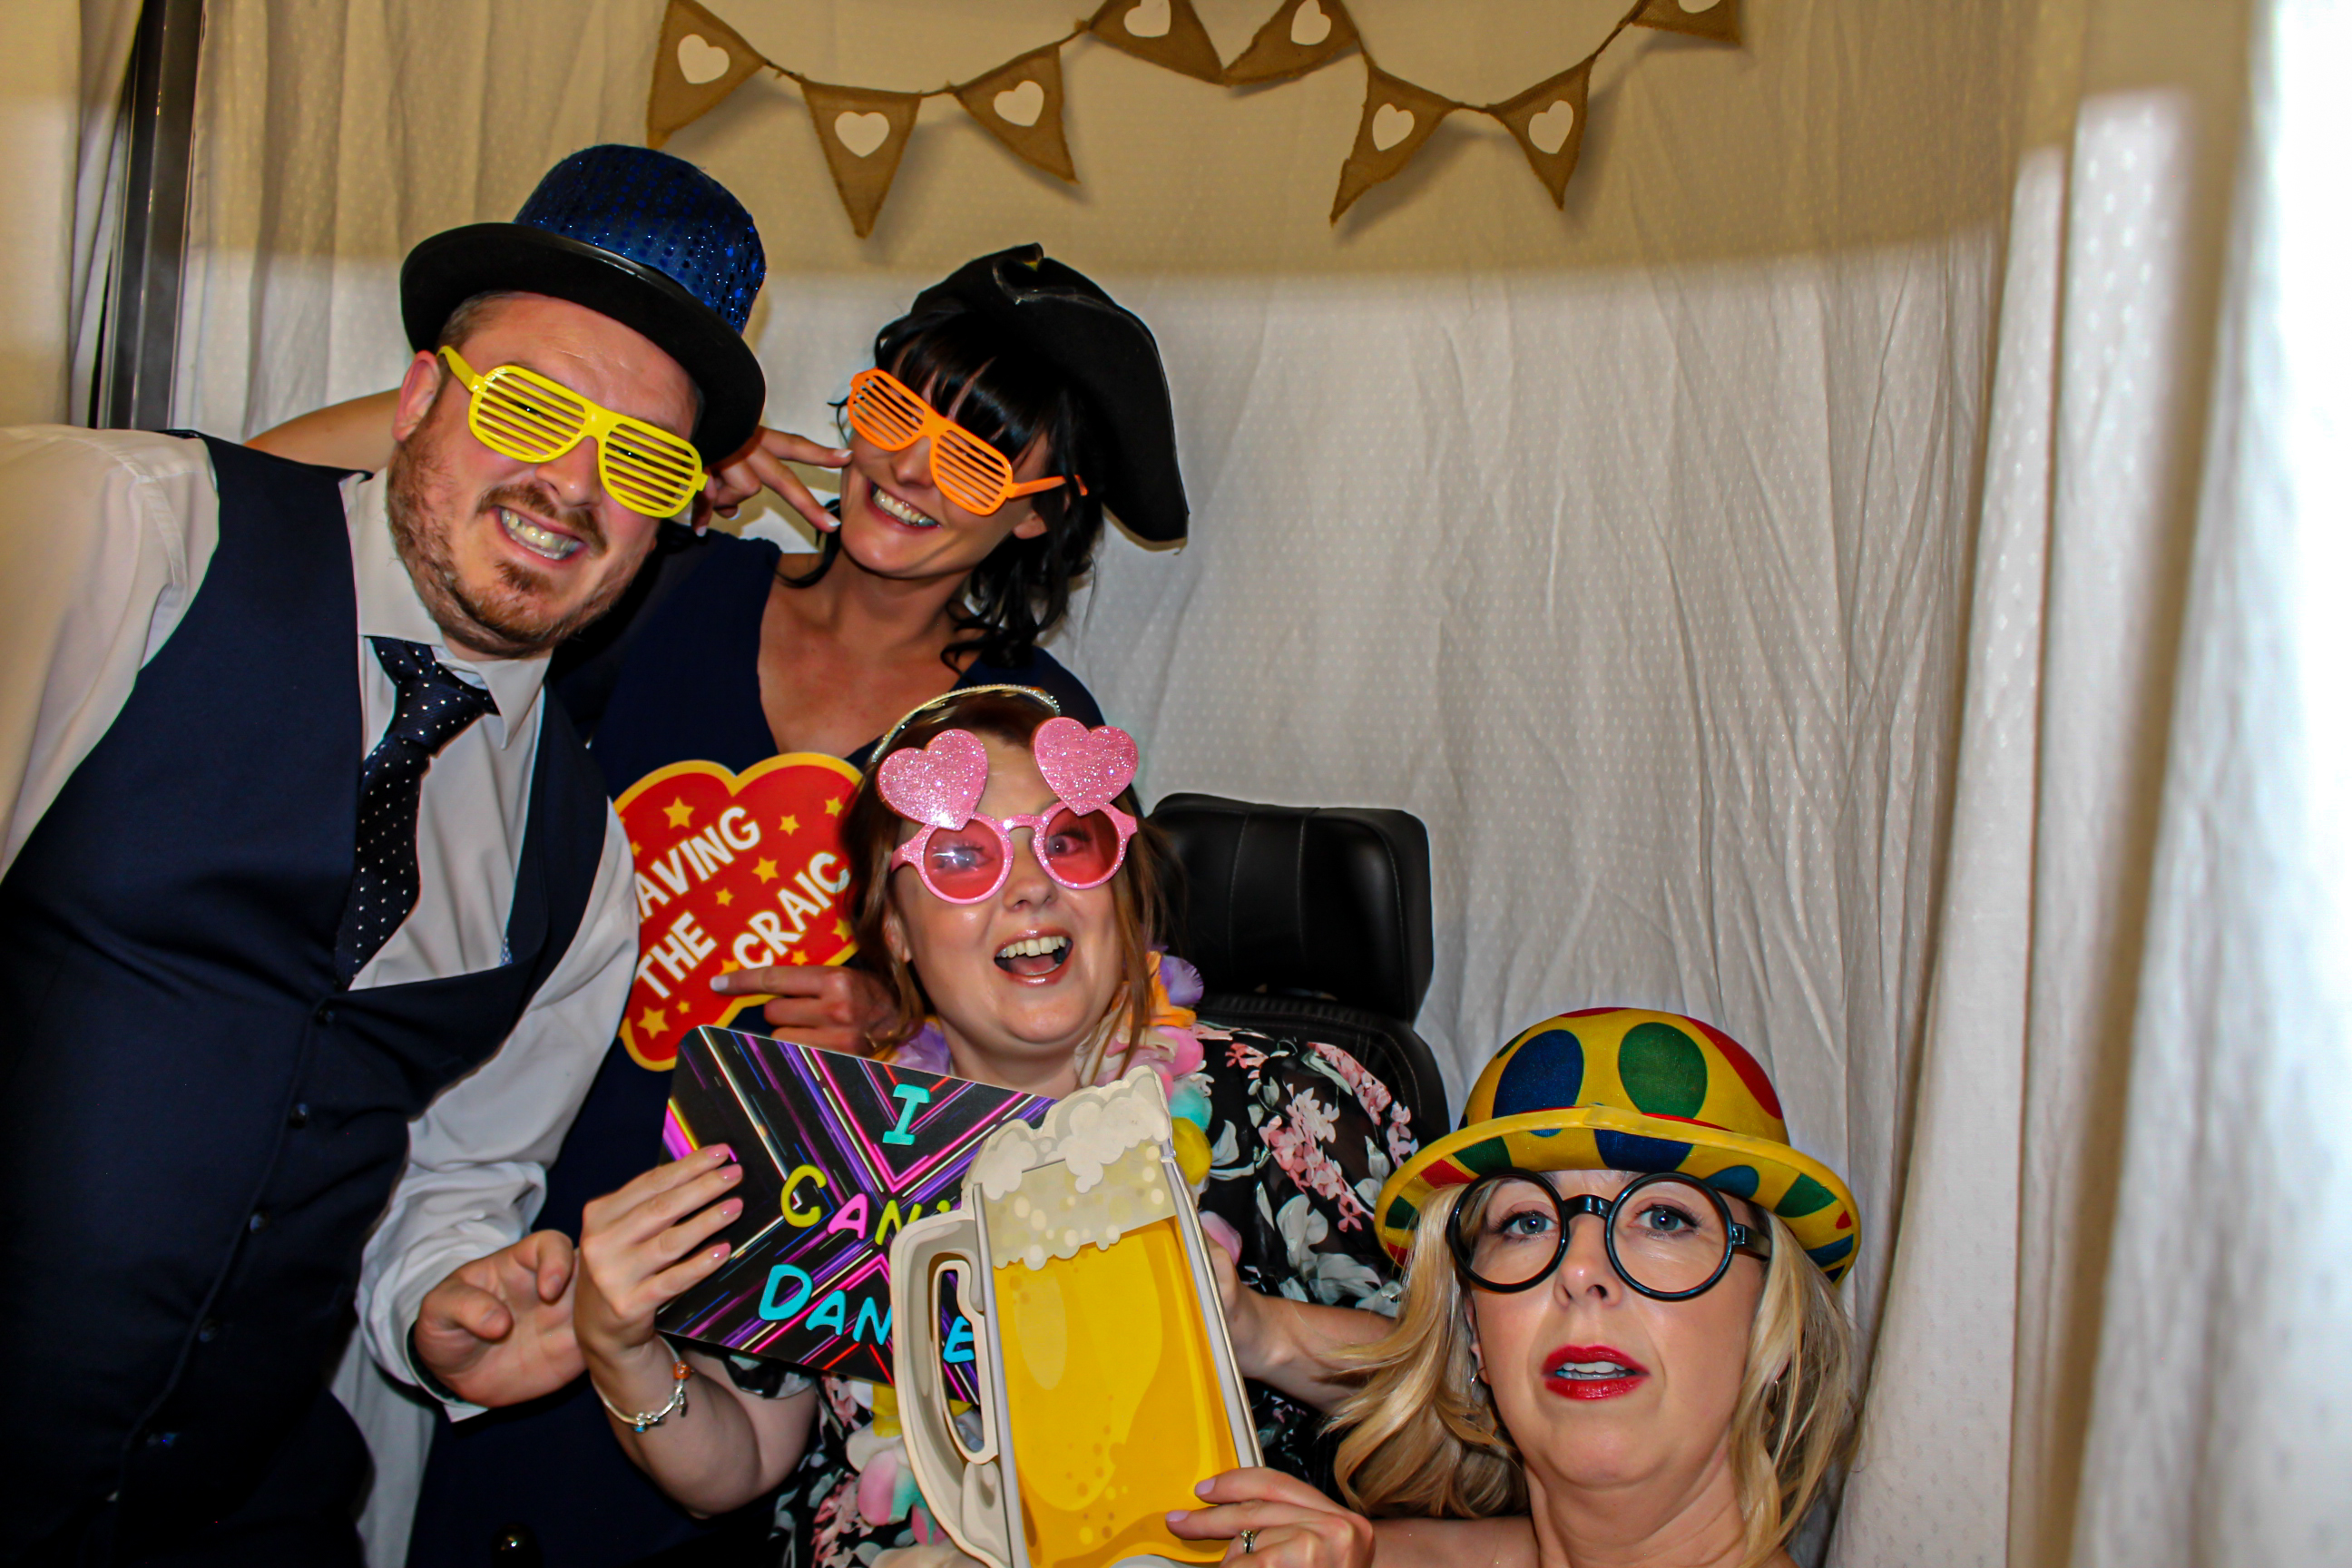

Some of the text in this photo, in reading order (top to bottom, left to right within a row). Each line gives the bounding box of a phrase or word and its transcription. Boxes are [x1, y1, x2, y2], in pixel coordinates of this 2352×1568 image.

[635, 807, 760, 924] AVING
[732, 852, 850, 969] CRAIC
[635, 911, 717, 999] THE
[882, 1083, 931, 1146] I
[780, 1164, 952, 1246] CAN'
[759, 1264, 975, 1363] DANE
